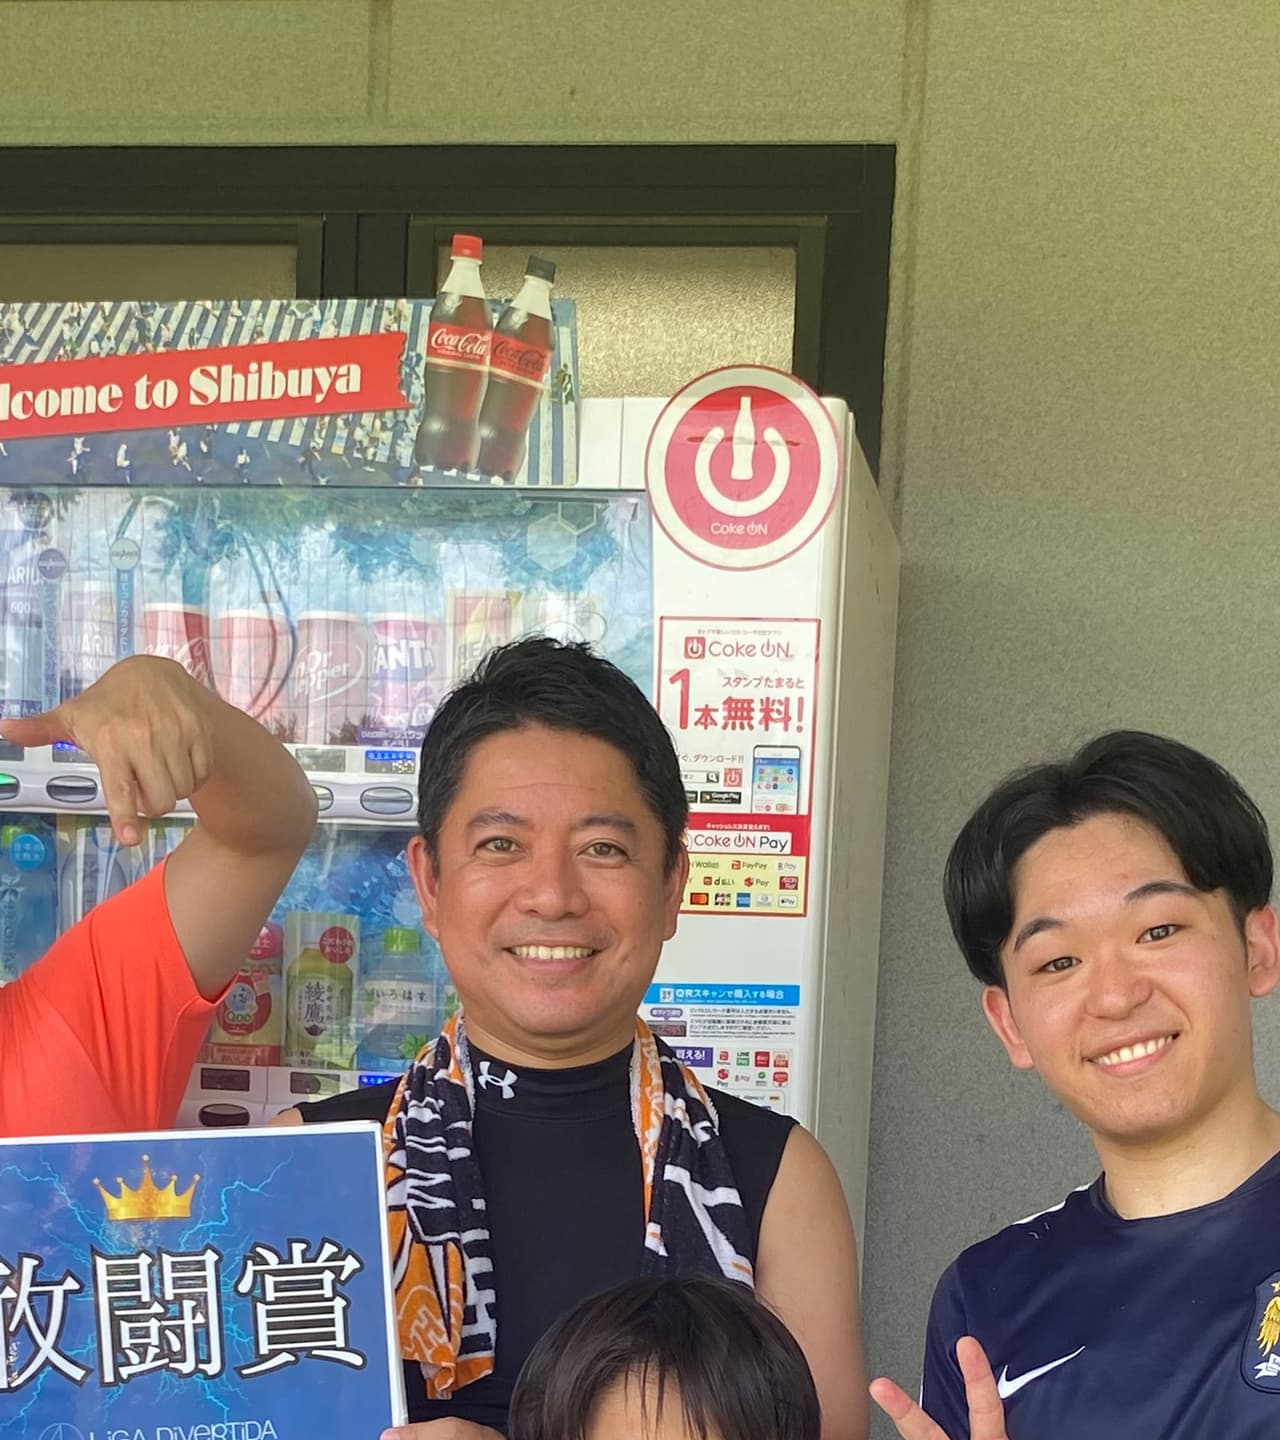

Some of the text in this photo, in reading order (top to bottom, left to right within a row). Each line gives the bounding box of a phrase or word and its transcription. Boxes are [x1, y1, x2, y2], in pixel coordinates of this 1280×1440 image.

[133, 374, 180, 410] to
[189, 361, 362, 407] Shibuya
[710, 522, 768, 535] Coke ON
[708, 639, 790, 658] Coke ON
[722, 676, 805, 689] スタンプたまると
[694, 834, 731, 847] Coke
[759, 836, 789, 852] Pay
